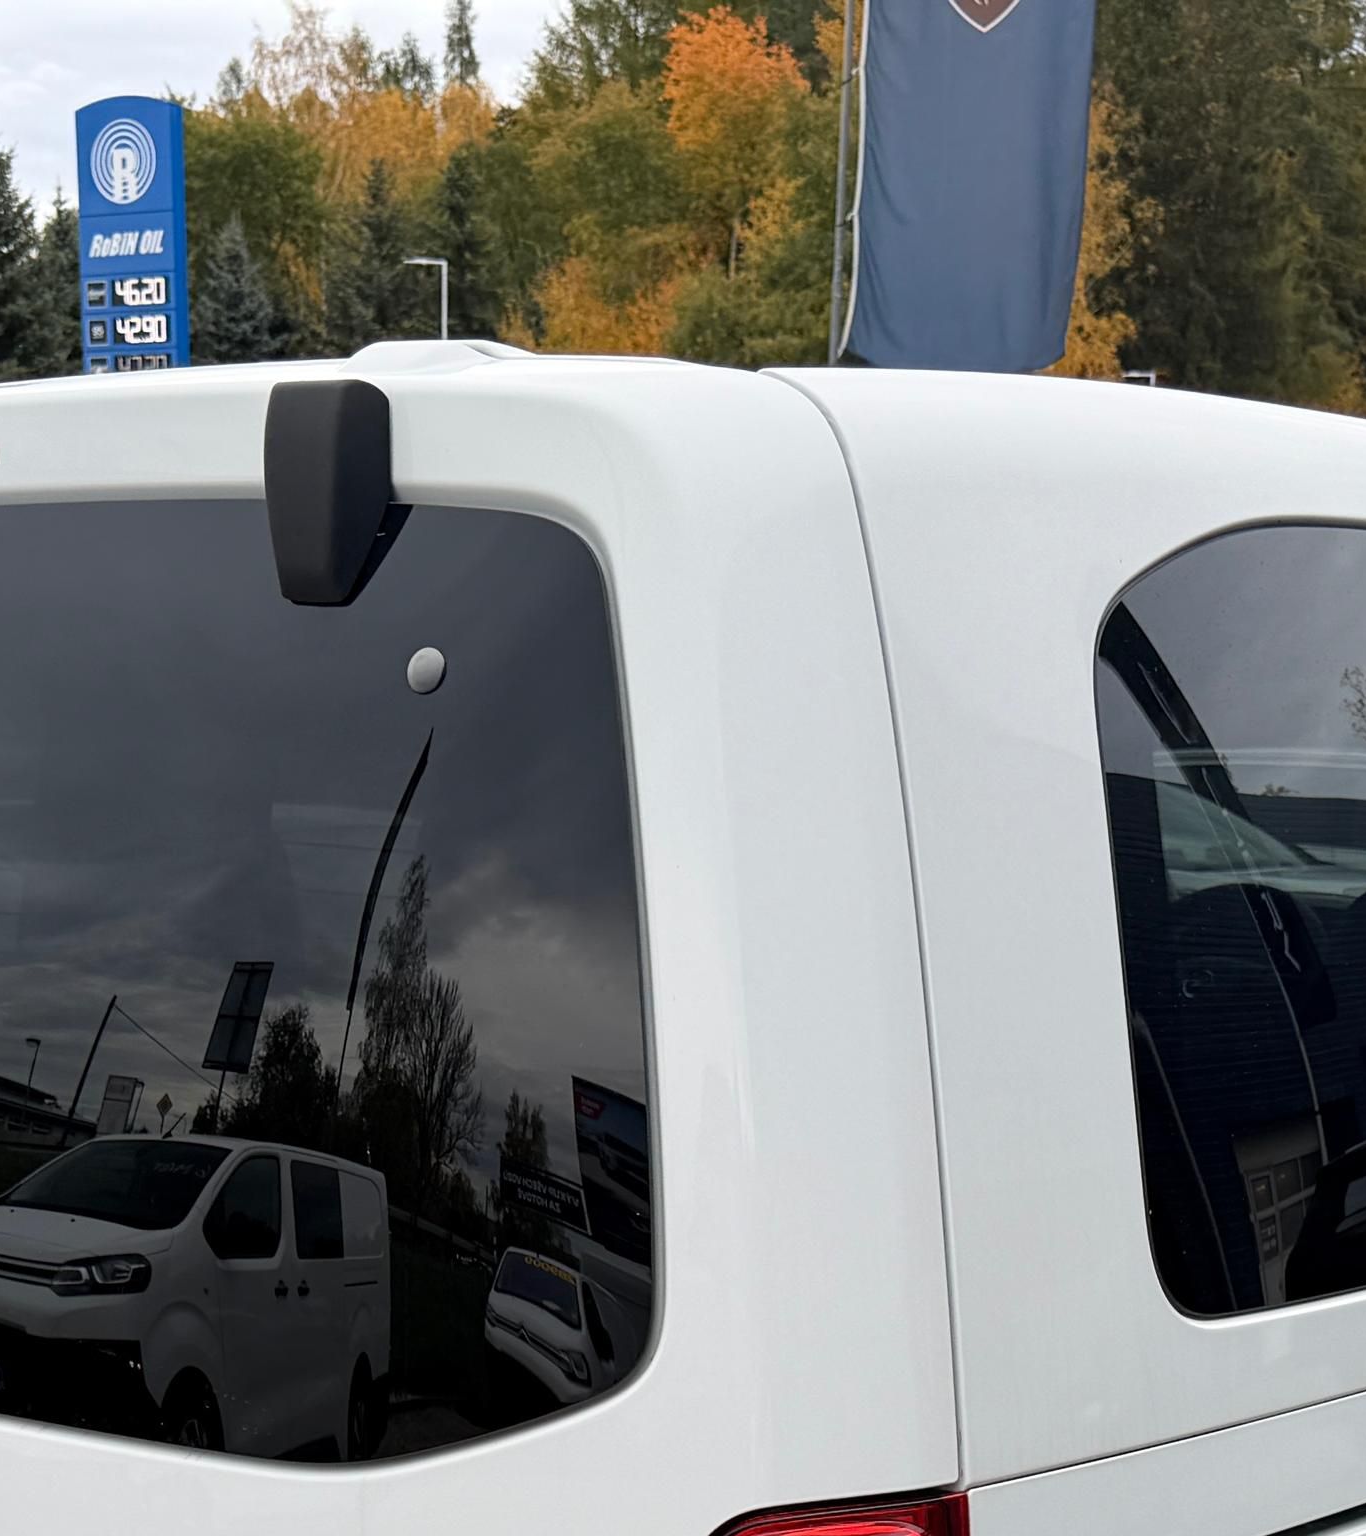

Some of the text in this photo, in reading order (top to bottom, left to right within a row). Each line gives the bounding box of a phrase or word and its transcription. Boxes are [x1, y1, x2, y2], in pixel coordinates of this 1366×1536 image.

[138, 229, 165, 256] OIL
[114, 277, 167, 306] 4620
[115, 314, 168, 344] 4290
